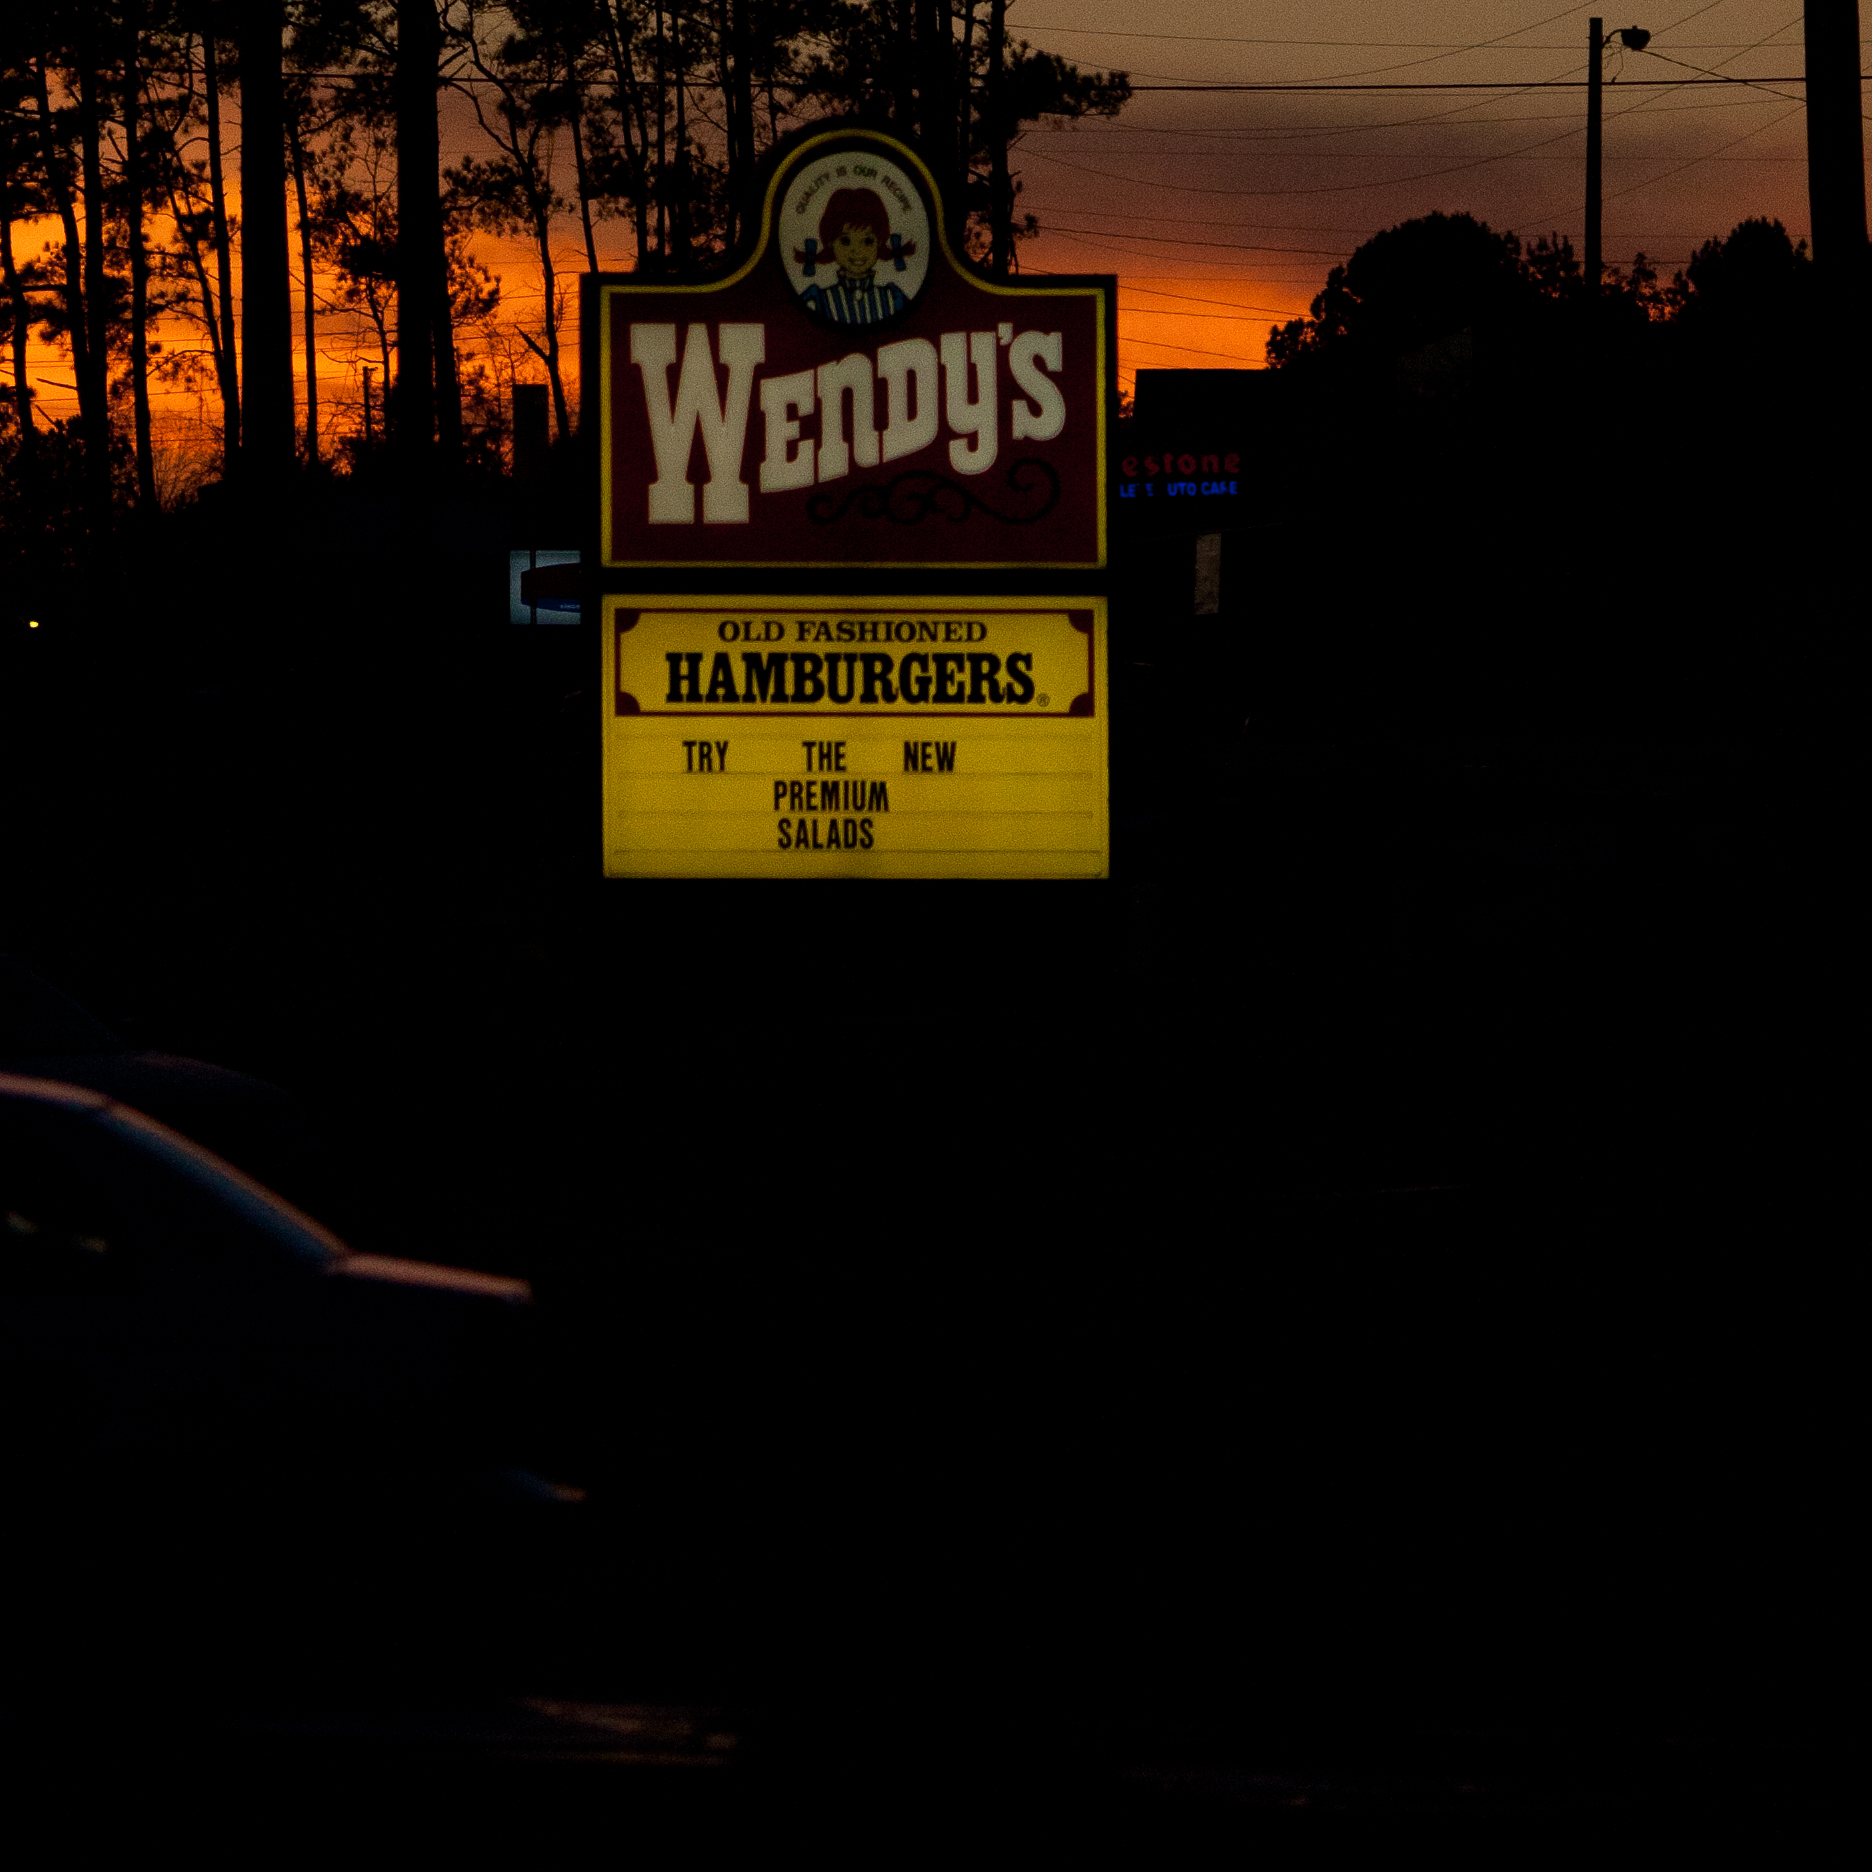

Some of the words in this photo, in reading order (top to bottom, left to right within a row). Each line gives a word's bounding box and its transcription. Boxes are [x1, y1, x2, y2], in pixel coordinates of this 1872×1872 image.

[796, 172, 830, 215] QUALITY
[836, 165, 847, 177] IS
[853, 165, 878, 180] OUR
[881, 175, 912, 213] RECIPE
[630, 322, 1066, 524] Wendy's
[1121, 452, 1241, 477] estone
[1167, 482, 1197, 497] UTO
[718, 620, 787, 644] OLD
[795, 620, 988, 644] FASHIONED
[665, 652, 1035, 705] HAMBURGERS
[682, 740, 730, 773] TRY
[801, 740, 847, 773] THE
[903, 740, 957, 773] NEW
[773, 781, 890, 812] PREMIUM
[778, 818, 875, 851] SALADS
